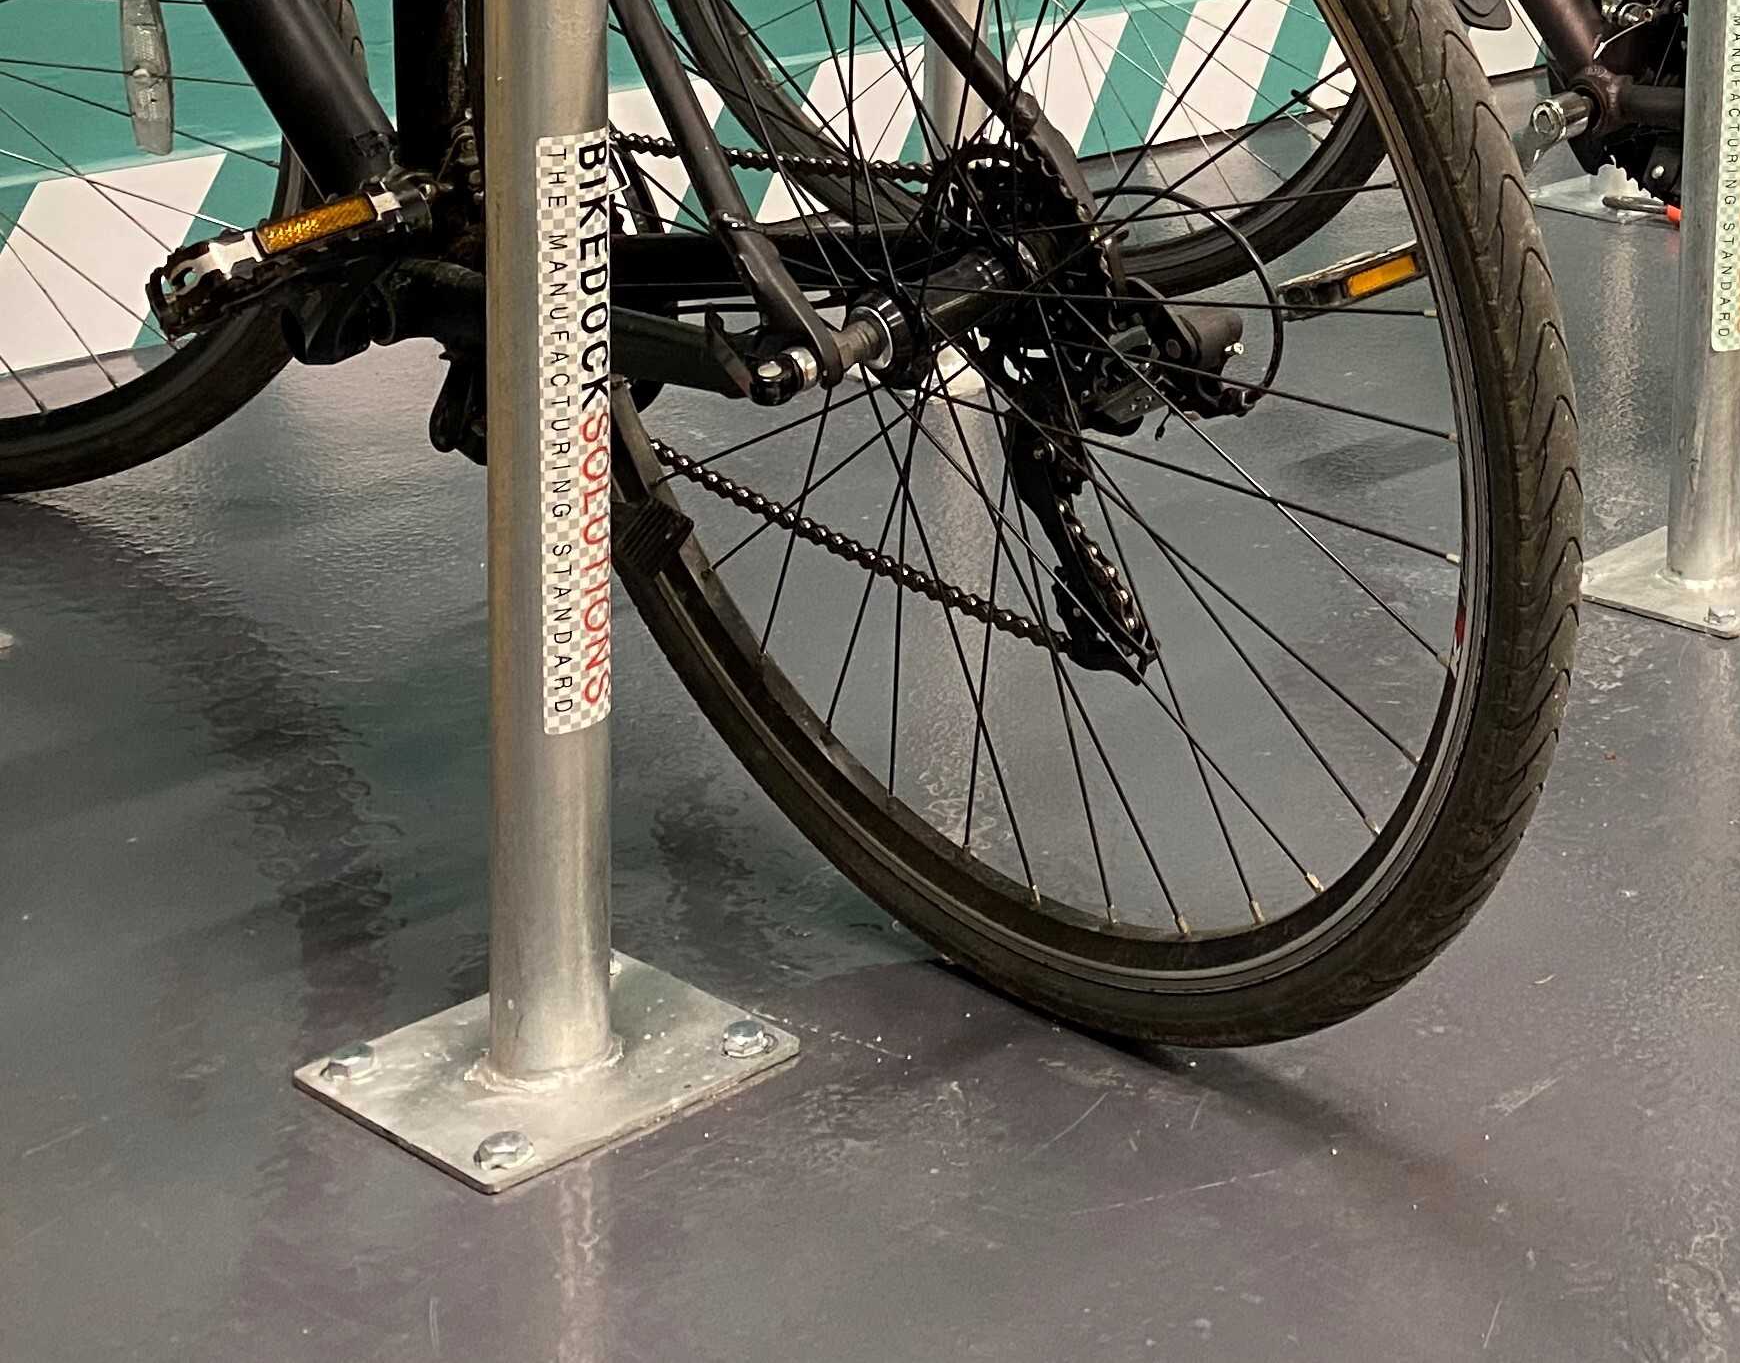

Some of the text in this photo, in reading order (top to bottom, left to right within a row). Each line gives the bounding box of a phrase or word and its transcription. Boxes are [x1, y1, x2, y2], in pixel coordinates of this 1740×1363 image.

[547, 148, 574, 714] THE MANUFACTURING STANDARD
[1718, 222, 1736, 338] STANDARD
